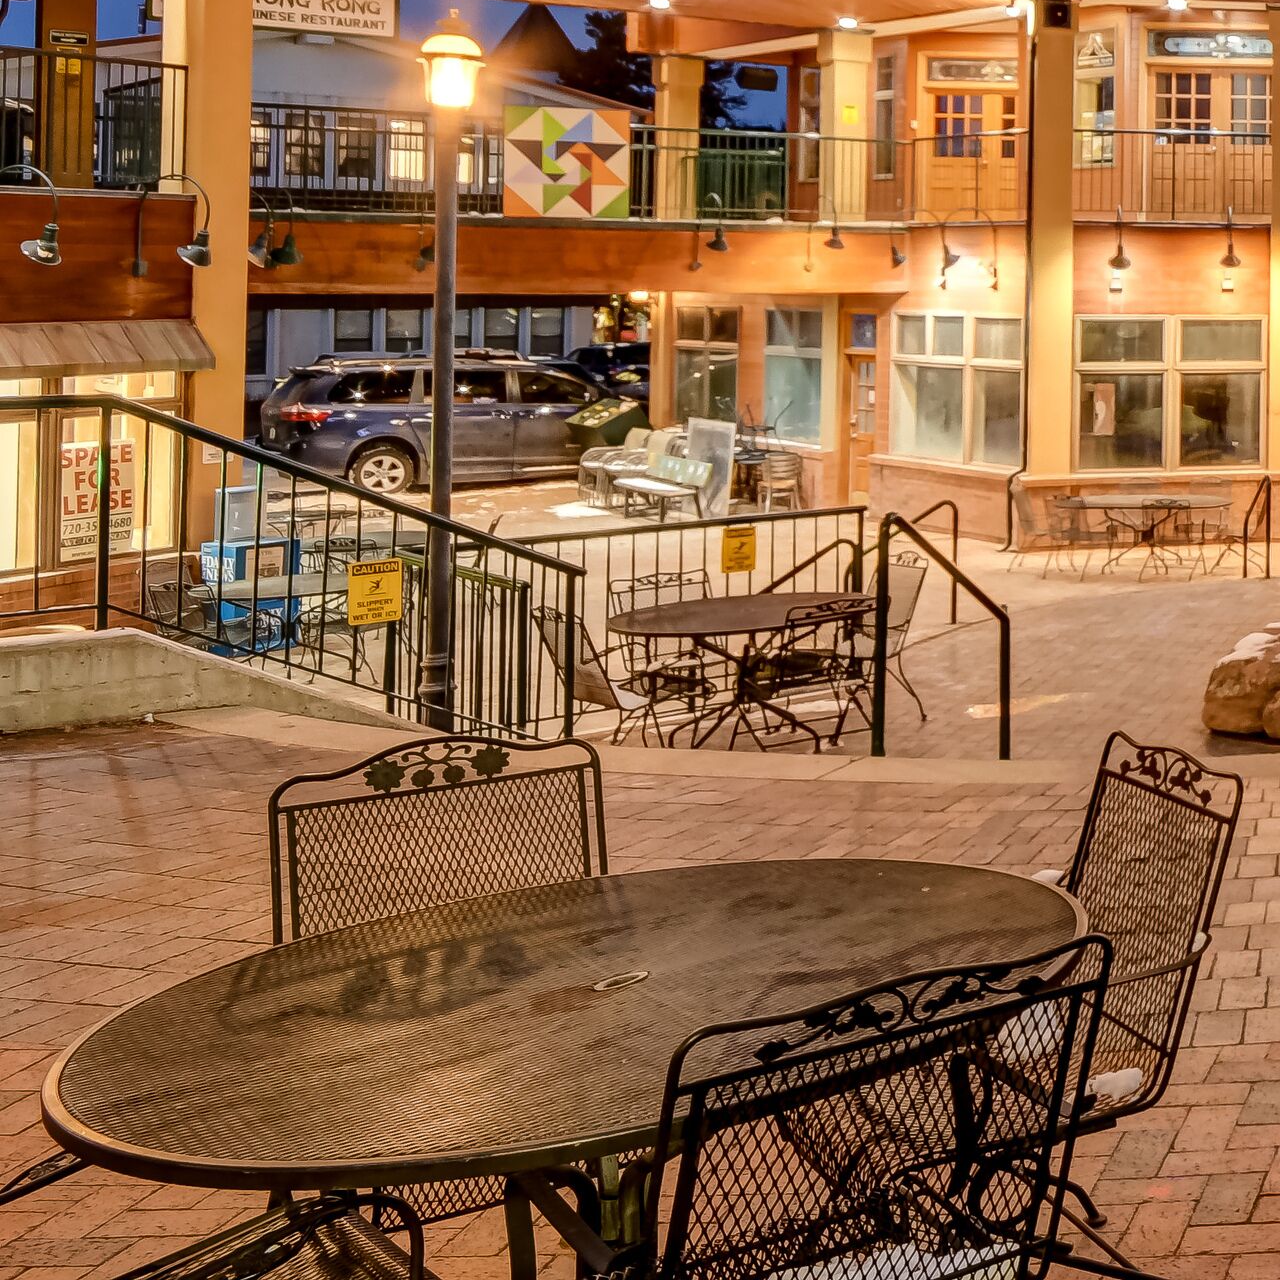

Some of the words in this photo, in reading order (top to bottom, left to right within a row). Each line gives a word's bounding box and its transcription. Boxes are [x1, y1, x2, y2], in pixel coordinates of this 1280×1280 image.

[252, 9, 296, 23] INESE
[301, 13, 387, 31] RESTAURANT
[353, 562, 398, 574] CAUTION
[356, 599, 394, 608] SLIPPERY
[352, 613, 369, 621] WET
